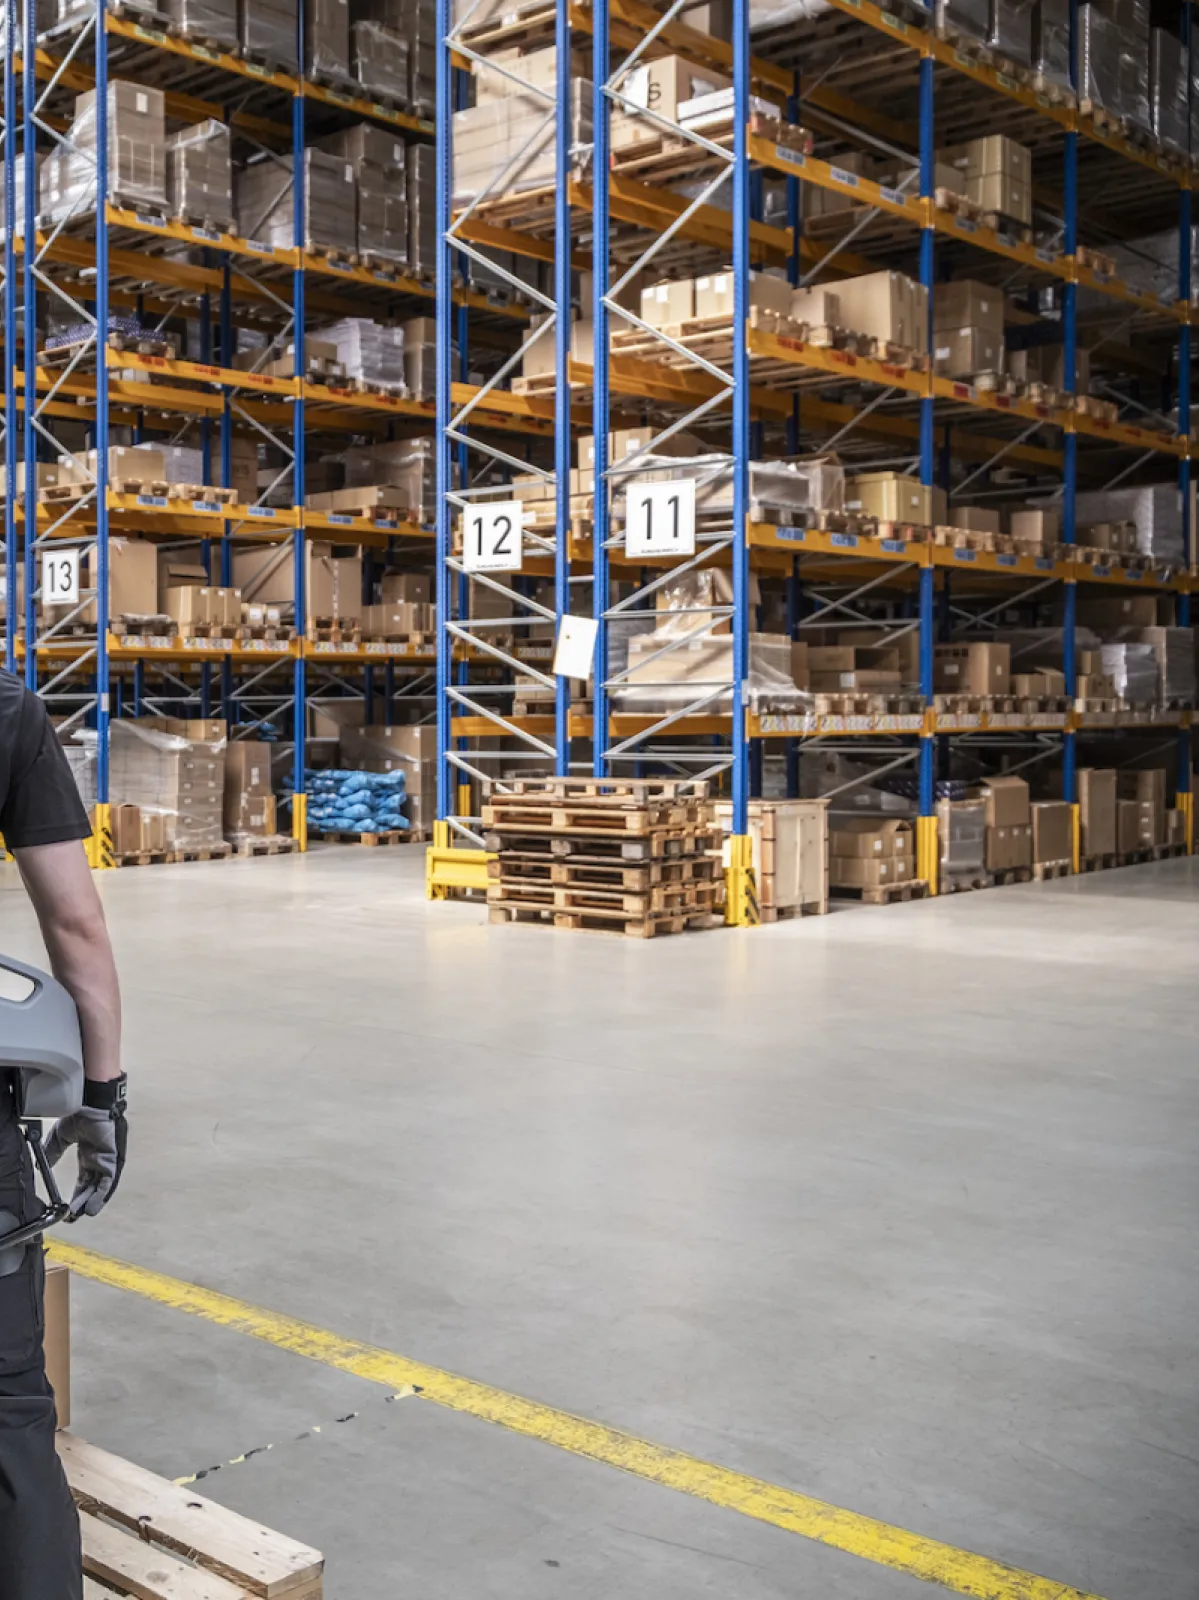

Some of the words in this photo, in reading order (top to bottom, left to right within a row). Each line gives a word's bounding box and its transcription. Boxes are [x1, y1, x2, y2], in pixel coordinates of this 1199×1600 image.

[472, 515, 512, 556] 12
[640, 494, 680, 541] 11
[48, 561, 72, 592] 13
